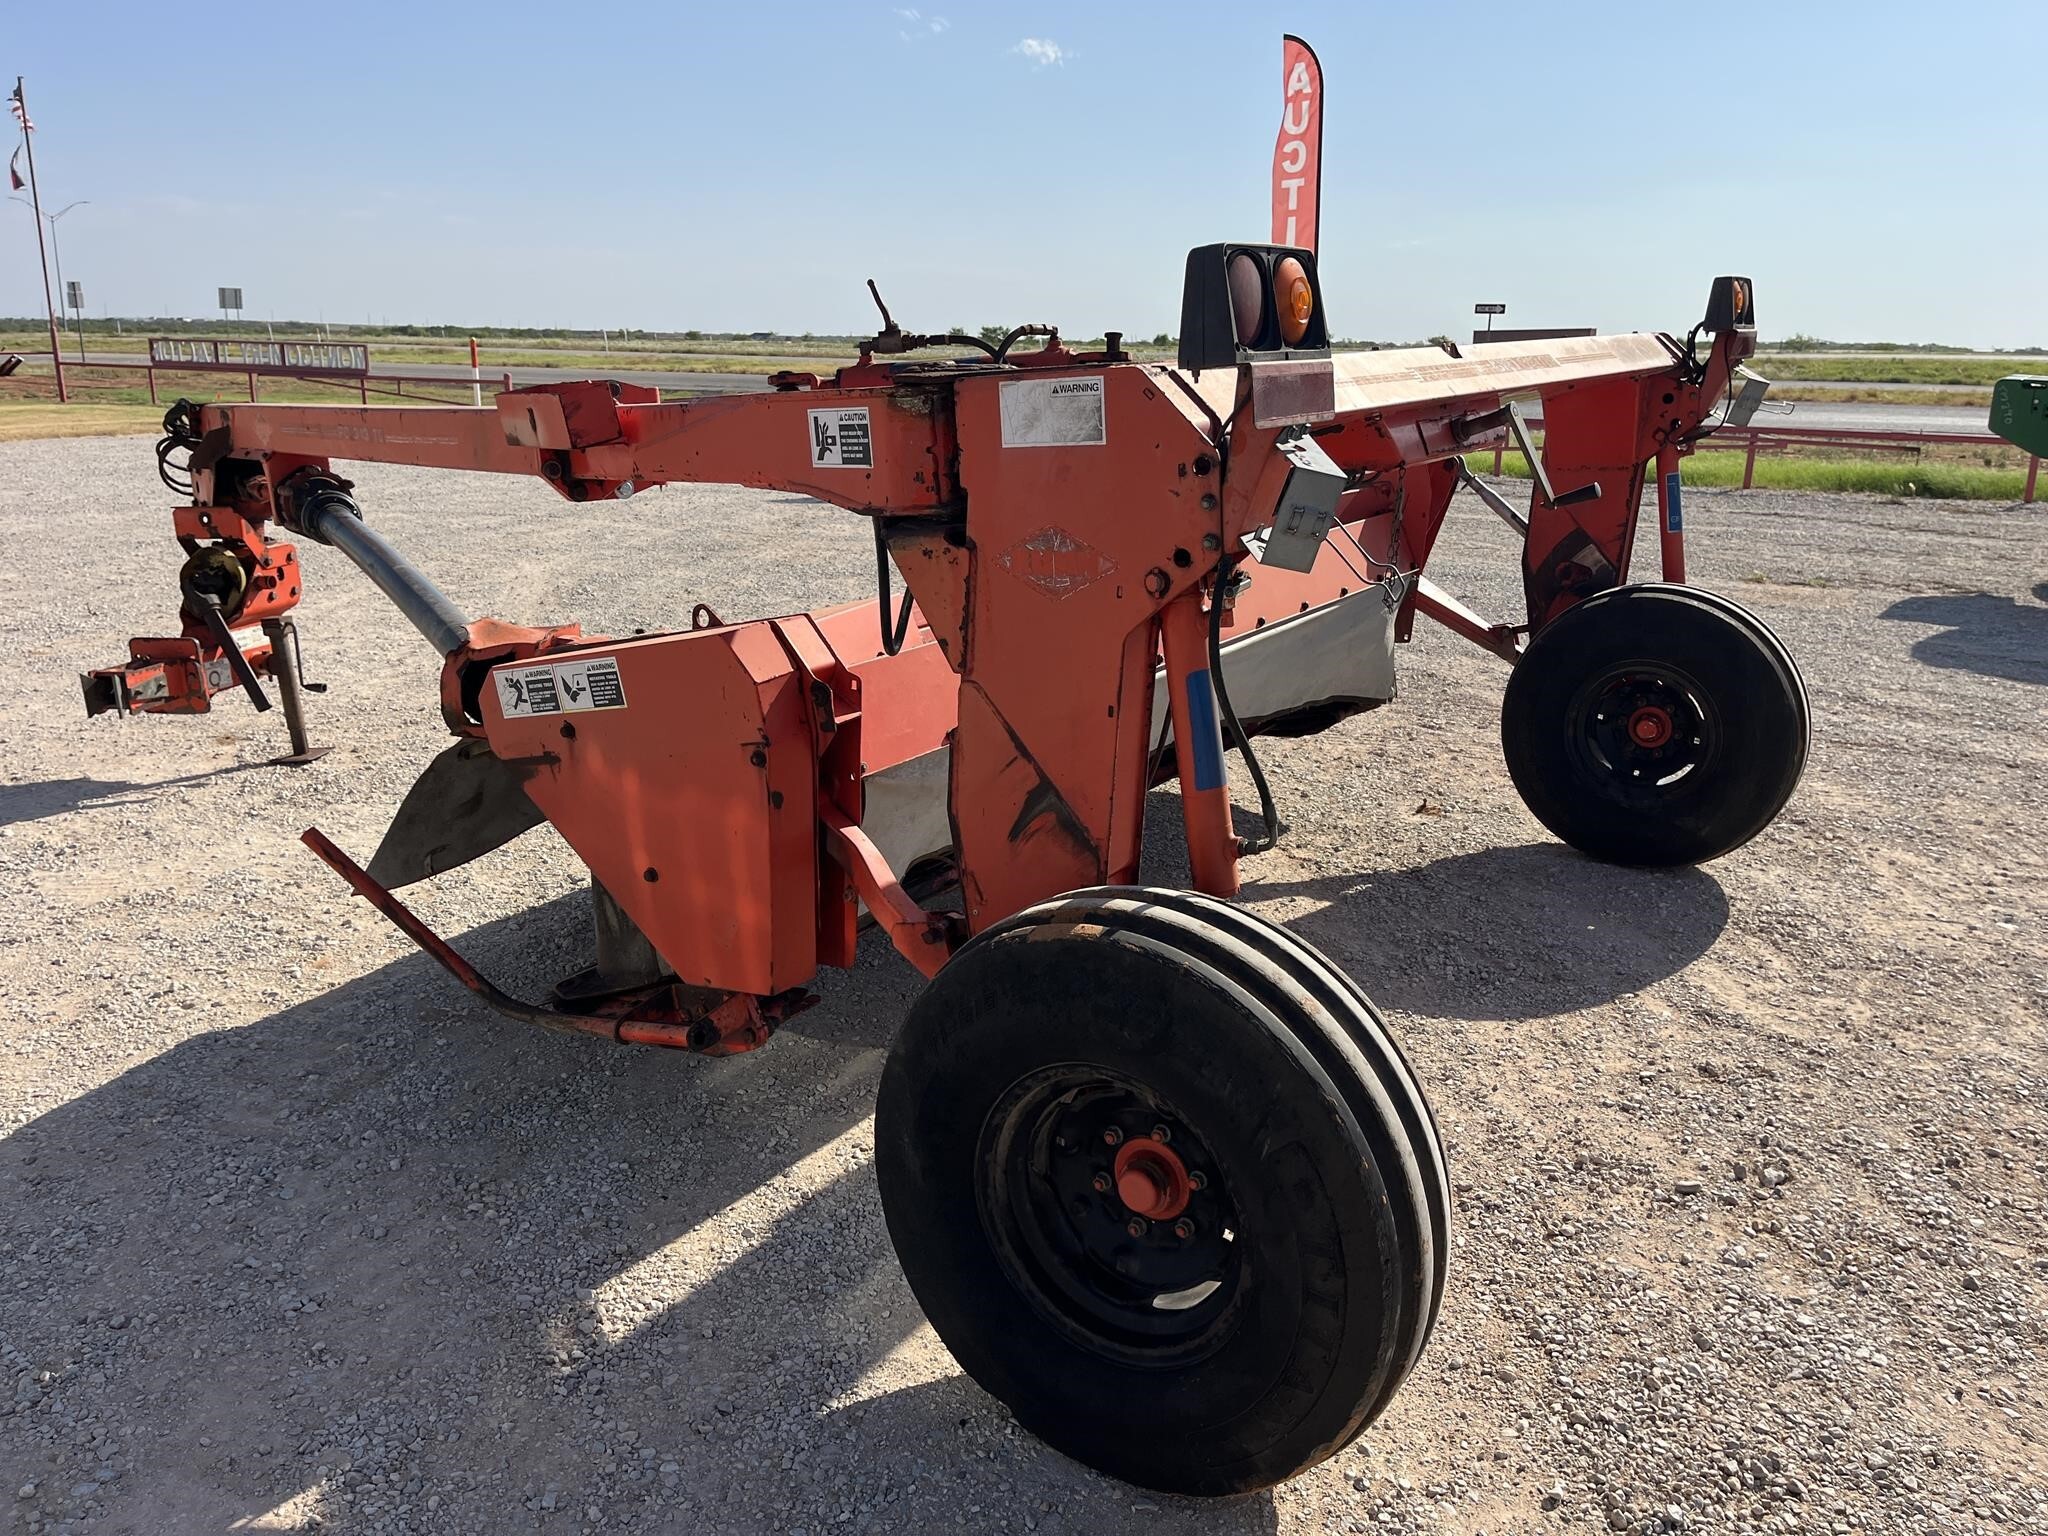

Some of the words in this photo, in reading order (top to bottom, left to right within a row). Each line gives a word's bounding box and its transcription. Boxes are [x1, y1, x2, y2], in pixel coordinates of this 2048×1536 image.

[1060, 383, 1099, 393] WARNING
[844, 413, 866, 421] CAUTION
[590, 662, 615, 671] WARNING
[530, 669, 552, 678] WARNING
